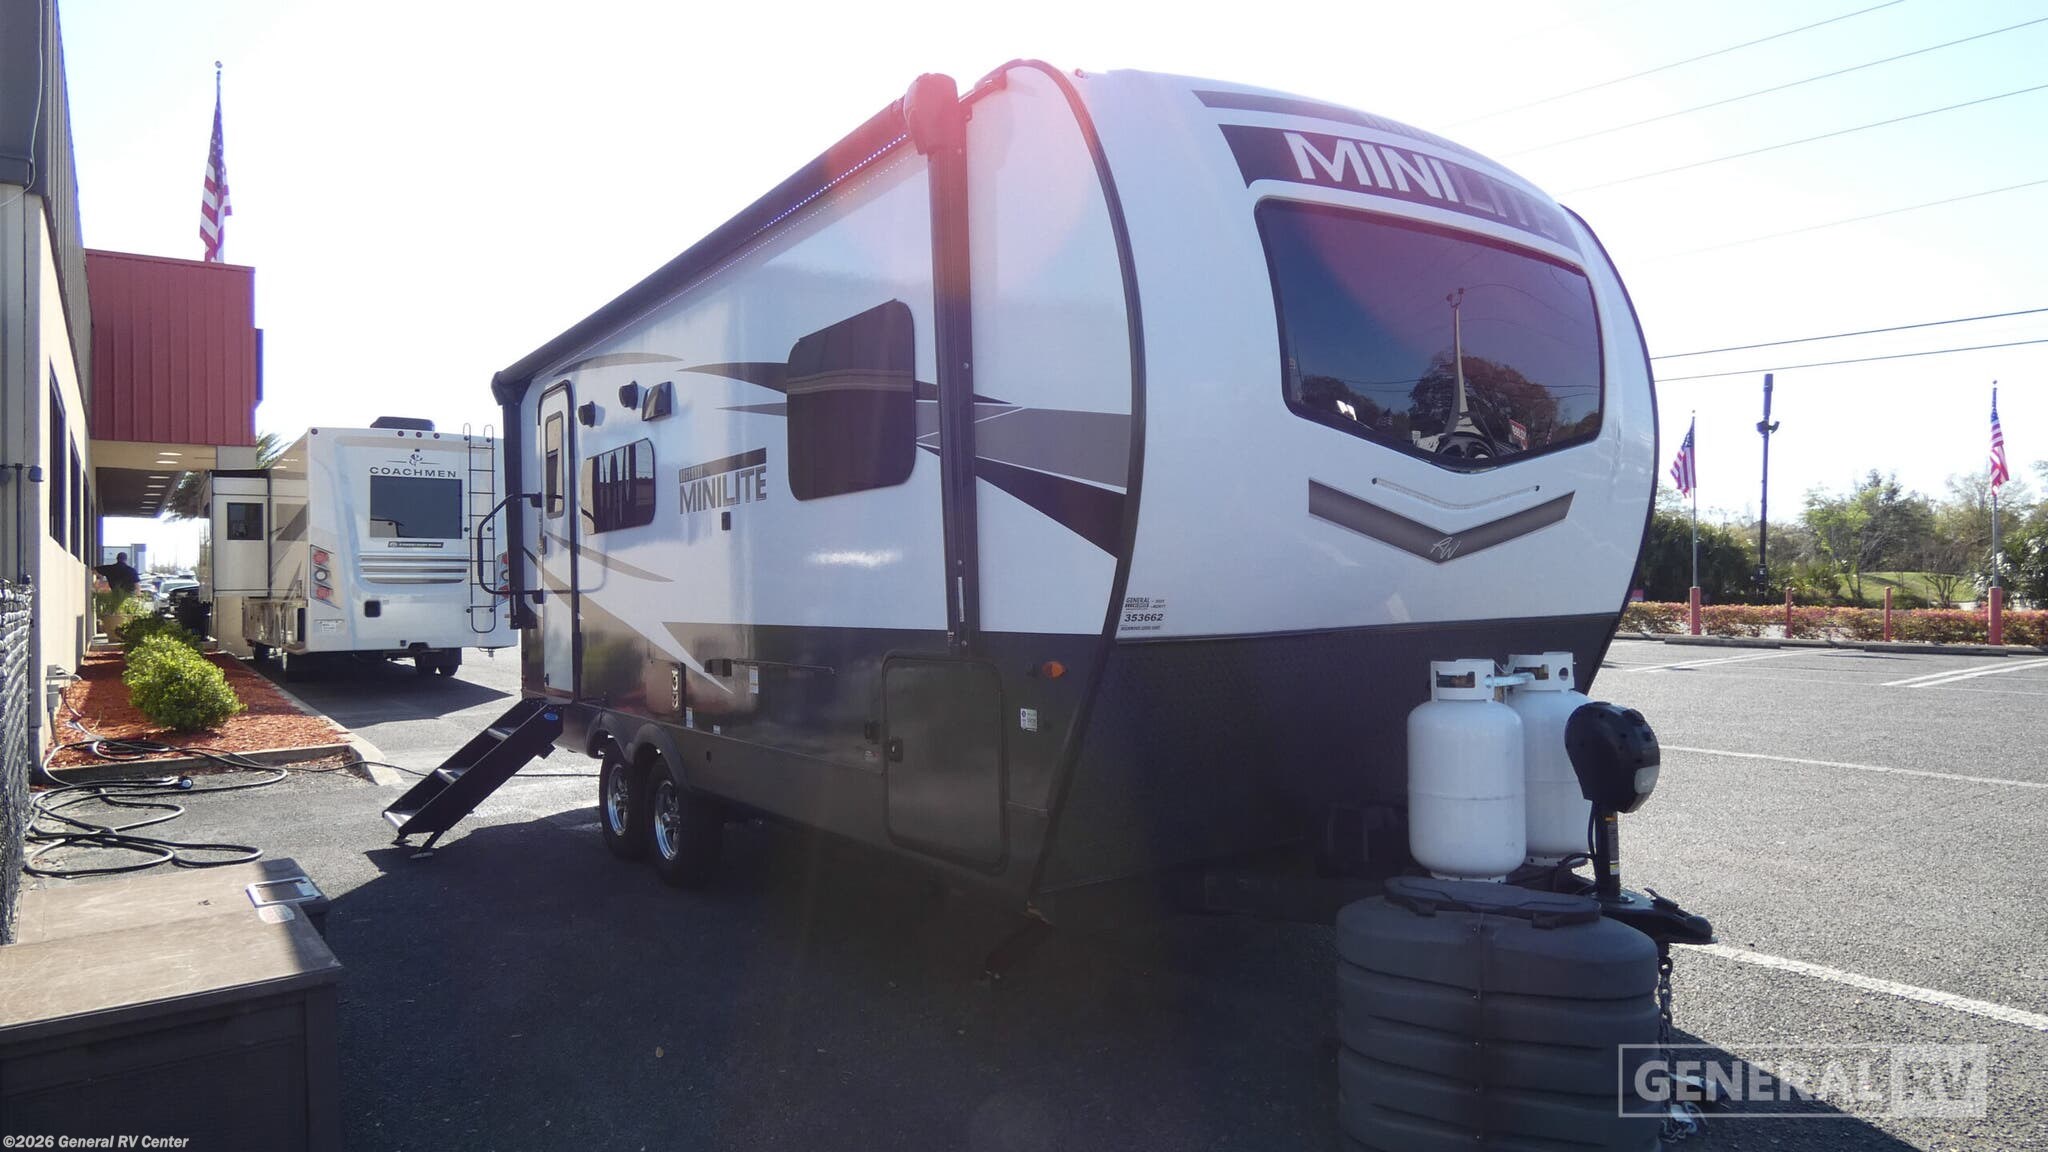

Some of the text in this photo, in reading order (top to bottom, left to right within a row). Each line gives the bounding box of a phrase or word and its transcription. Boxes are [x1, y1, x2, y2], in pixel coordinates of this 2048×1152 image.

[1283, 131, 1560, 241] MINILITE
[369, 466, 457, 478] COACHMEN
[679, 465, 767, 514] MINILITE
[1124, 613, 1164, 622] 353662
